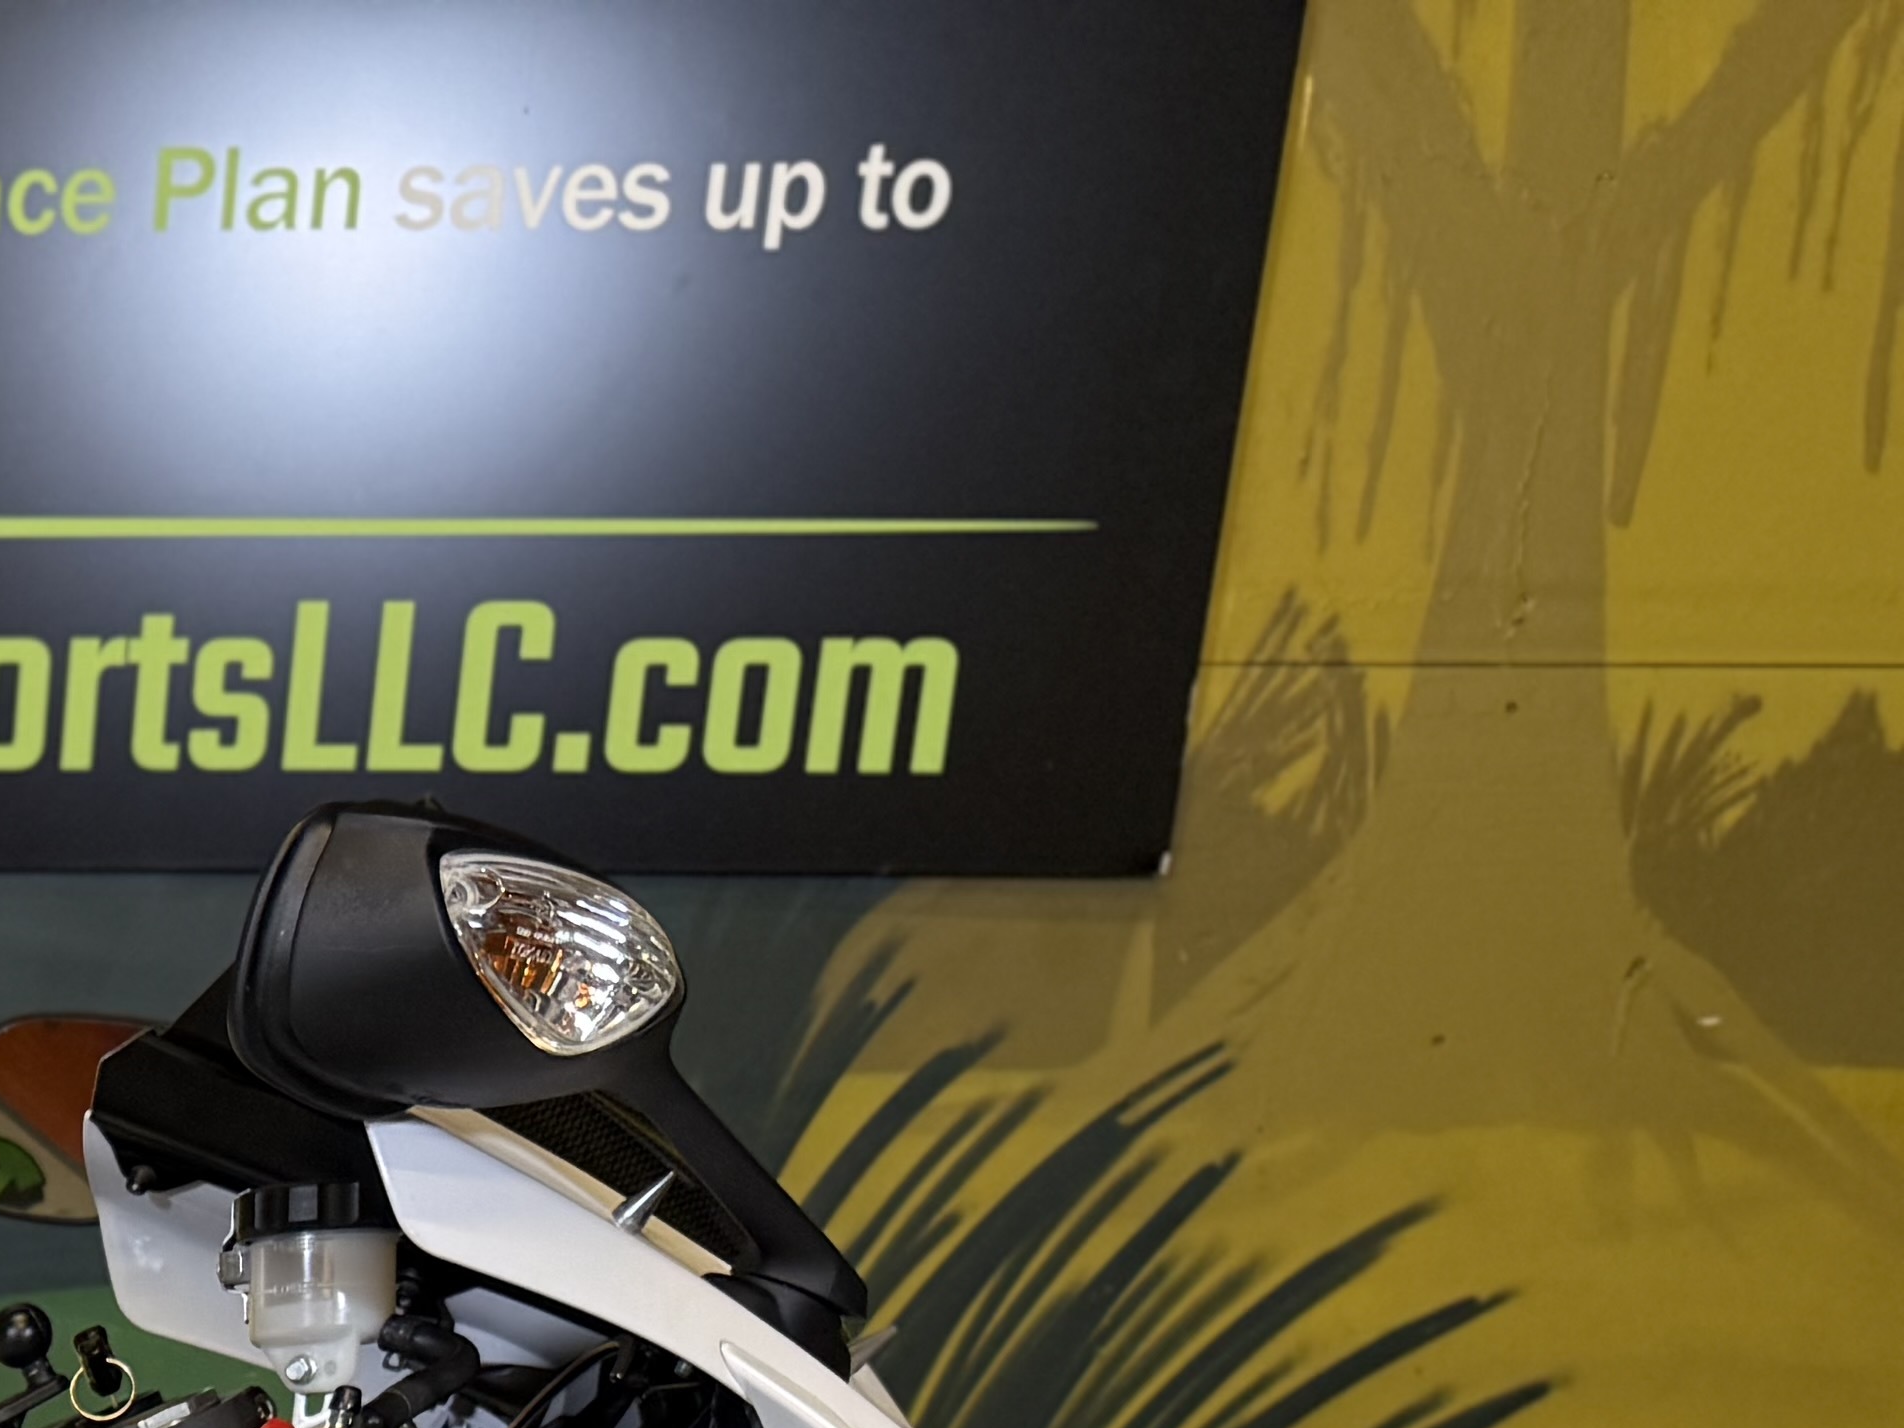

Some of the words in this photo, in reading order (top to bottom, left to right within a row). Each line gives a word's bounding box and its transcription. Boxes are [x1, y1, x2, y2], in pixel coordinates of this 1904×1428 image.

[152, 145, 362, 231] Plan
[394, 162, 672, 231] saves
[703, 162, 825, 250] up
[856, 143, 953, 230] to
